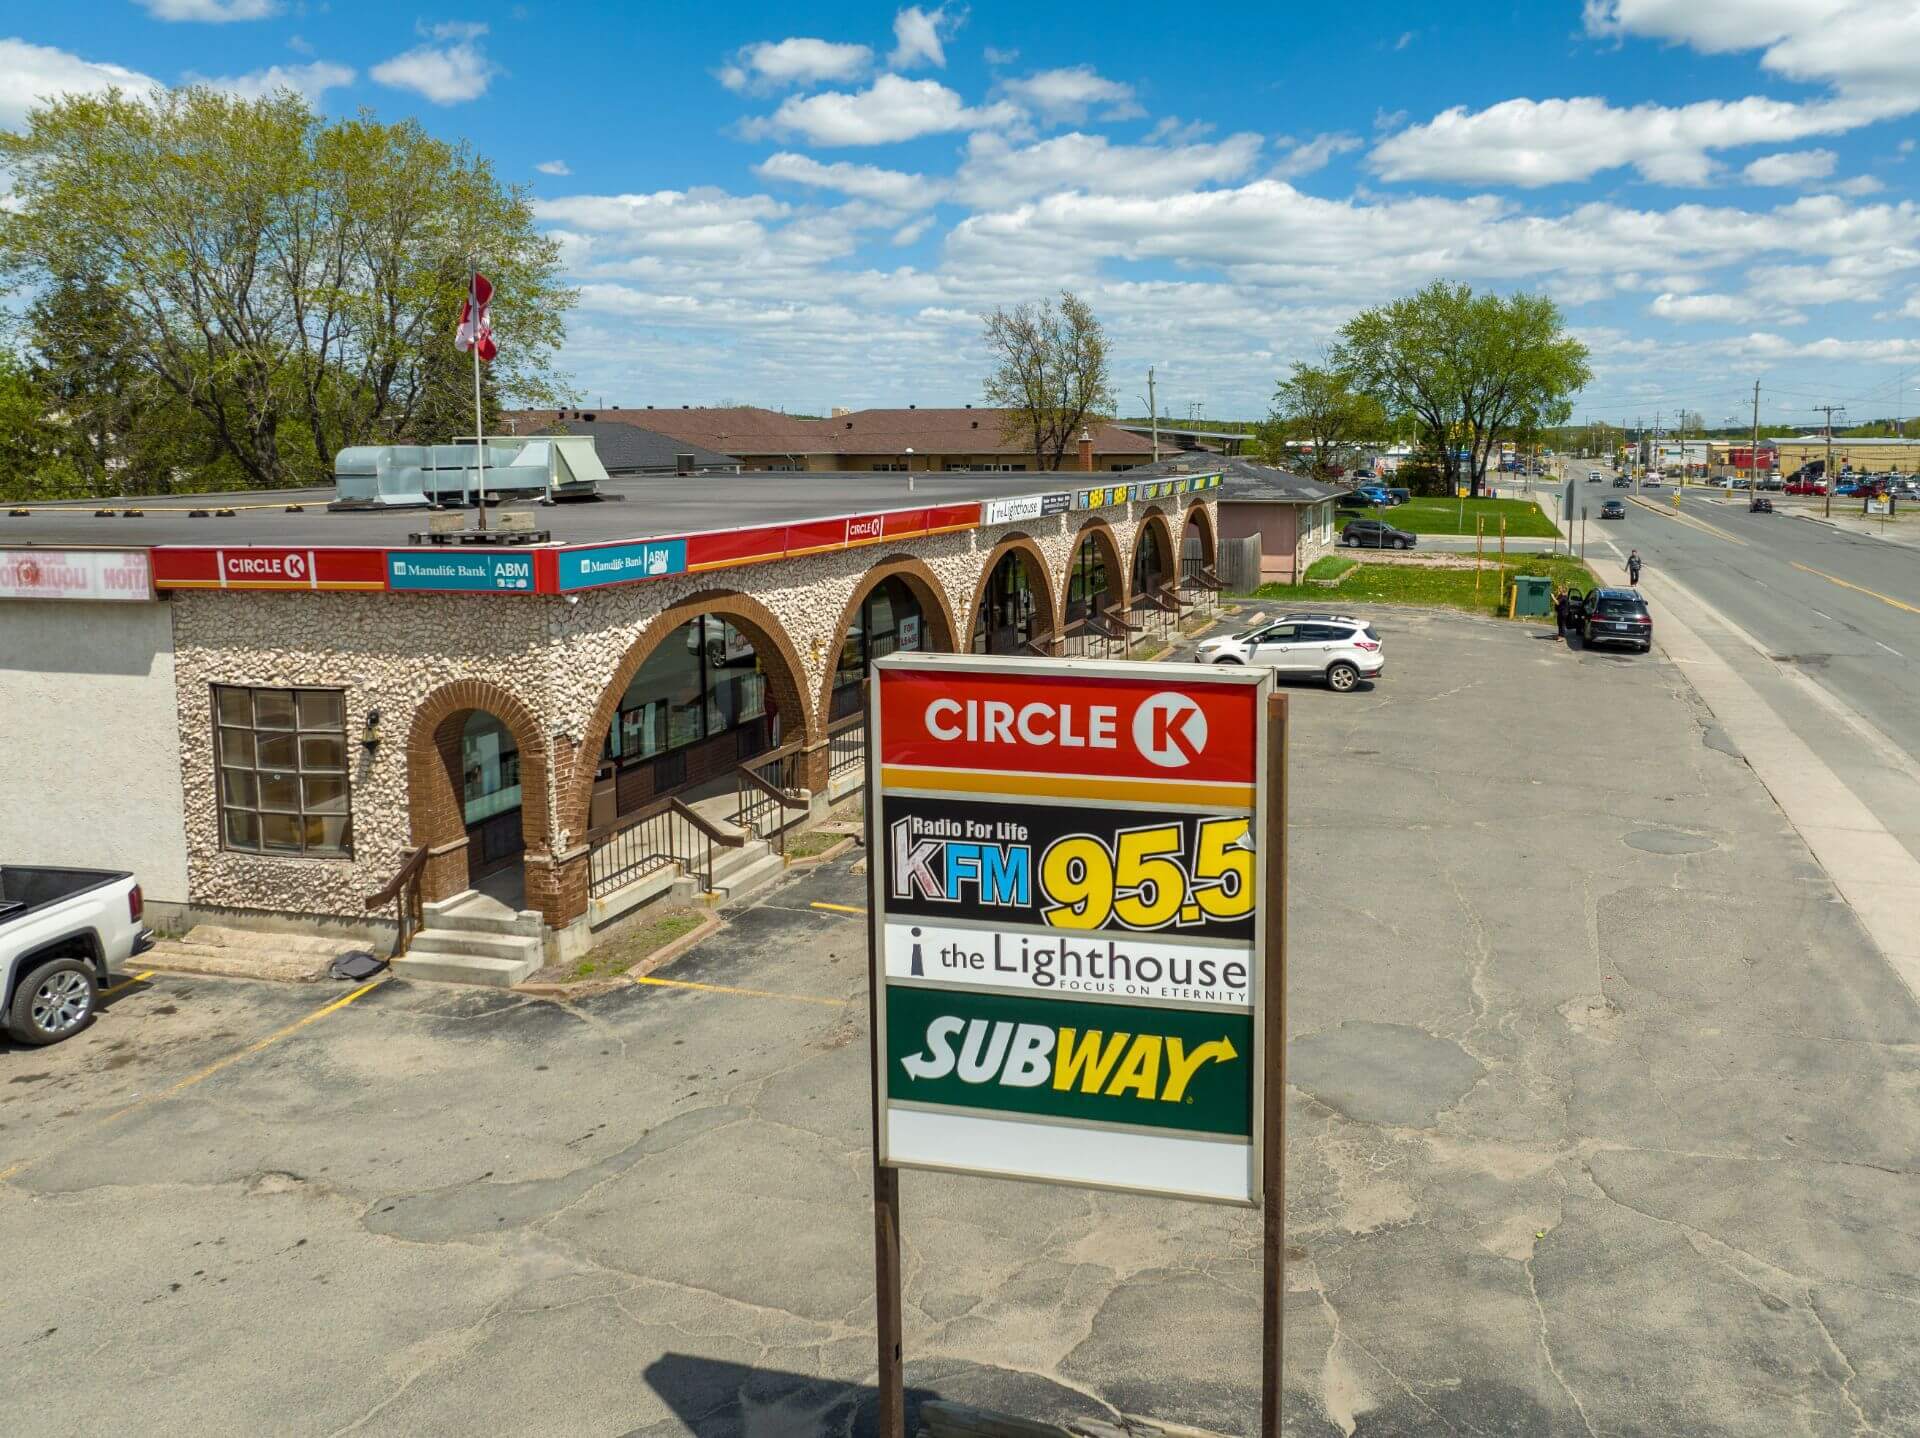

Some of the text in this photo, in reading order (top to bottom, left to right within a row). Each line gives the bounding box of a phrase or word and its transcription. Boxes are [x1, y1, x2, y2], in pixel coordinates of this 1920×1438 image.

[850, 519, 880, 536] CIRCLE K
[228, 556, 304, 577] CIRCLE K
[648, 549, 669, 564] ABM
[408, 563, 529, 577] Manulife Bank ABM
[924, 698, 1208, 767] CIRCLE K
[912, 817, 1029, 841] Radio For Life
[891, 814, 1256, 931] KFM 95.5
[940, 933, 1248, 988] the Lighthouse
[1060, 980, 1246, 1002] FOCUS ON ETERNITY
[901, 1015, 1238, 1103] SUBWAY
